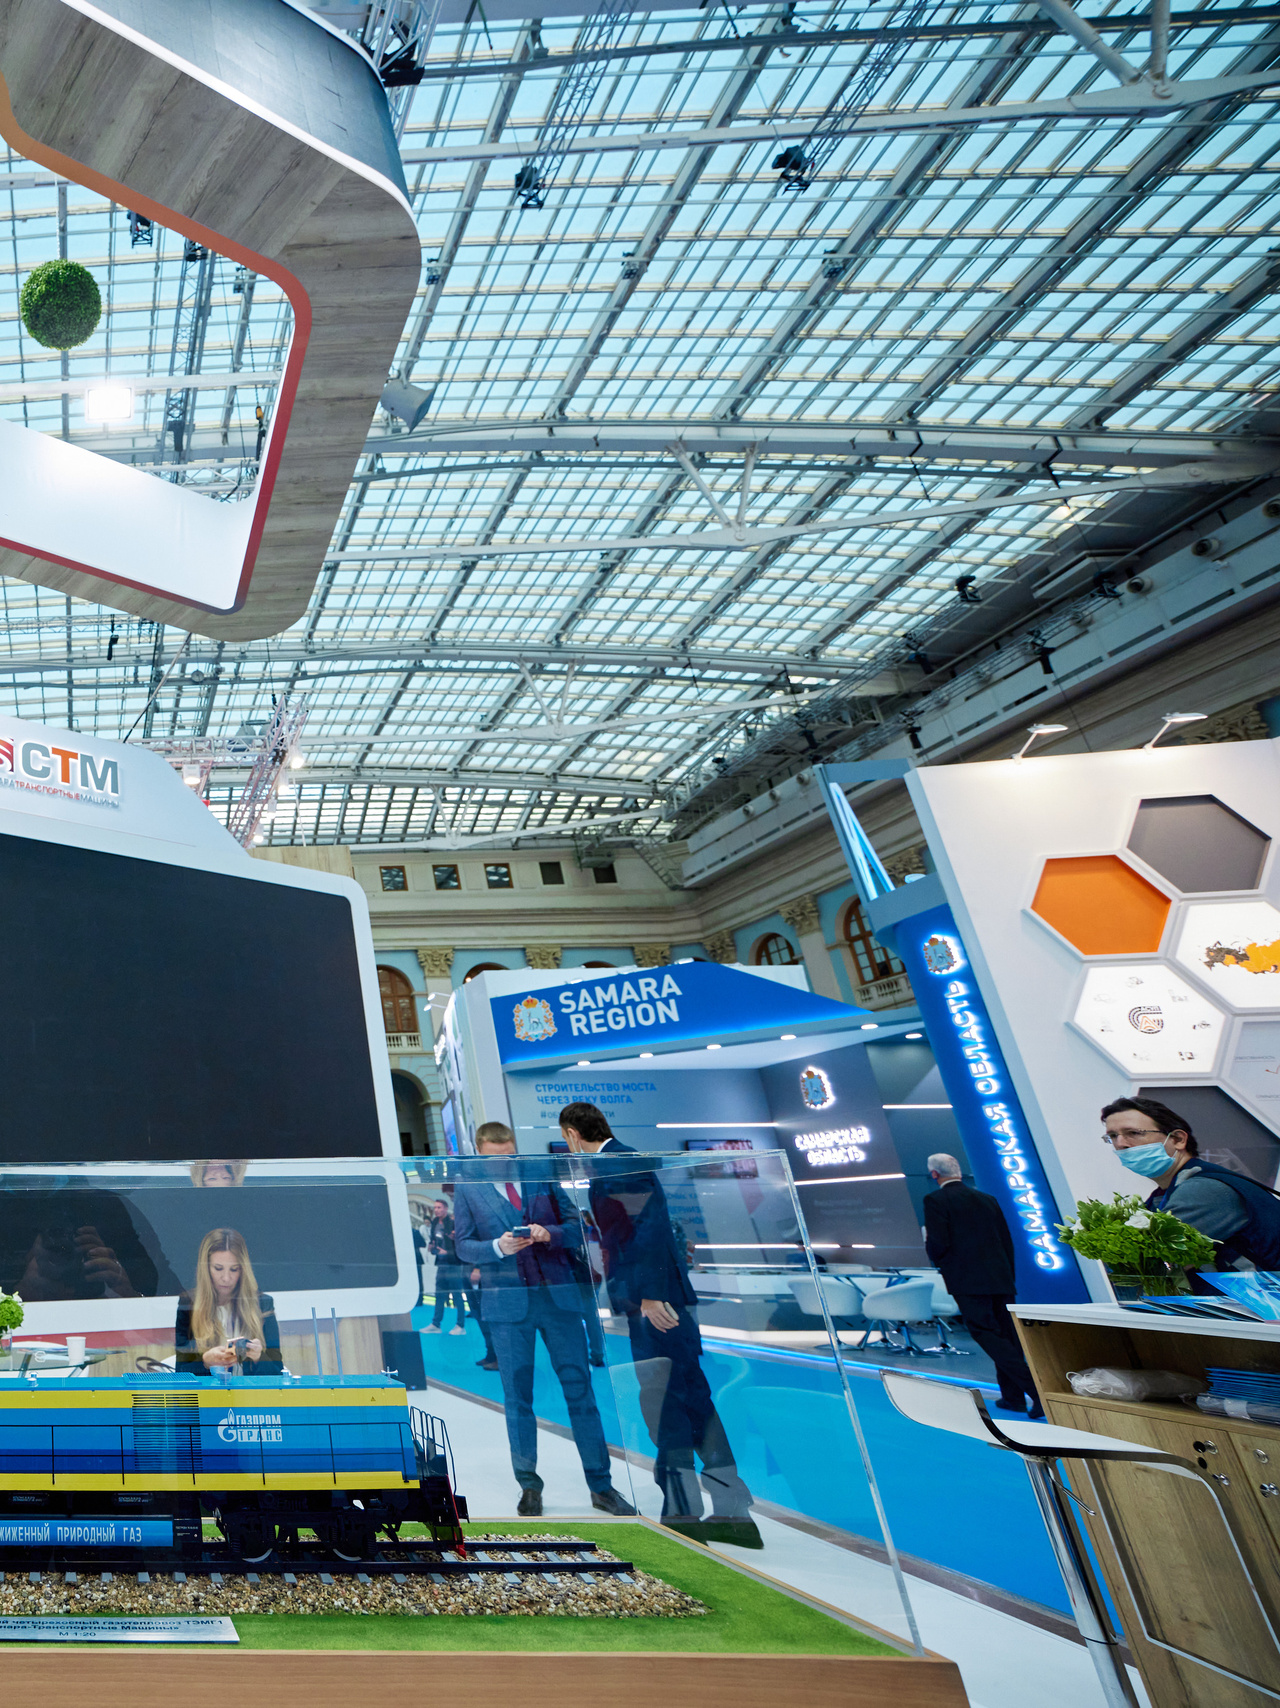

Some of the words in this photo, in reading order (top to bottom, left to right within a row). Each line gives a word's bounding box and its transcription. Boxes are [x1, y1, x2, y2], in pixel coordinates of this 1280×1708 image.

[21, 742, 119, 795] СТМ
[559, 974, 683, 1013] SAMARA
[570, 999, 680, 1036] REGION
[535, 1083, 620, 1093] СТРОИТЕЛЬСТВО
[621, 1082, 657, 1092] МОСТА
[537, 1095, 570, 1105] ЧЕРЕЗ
[572, 1095, 598, 1104] РЕКУ
[600, 1094, 634, 1104] ВОЛГА
[982, 1102, 1064, 1272] САМАРСКАЯ
[236, 1414, 281, 1428] ГАЗПРОМ
[238, 1430, 282, 1441] ТРАНС
[57, 1523, 116, 1545] ПРИРОДНЫЙ
[122, 1527, 142, 1543] ГАЗ
